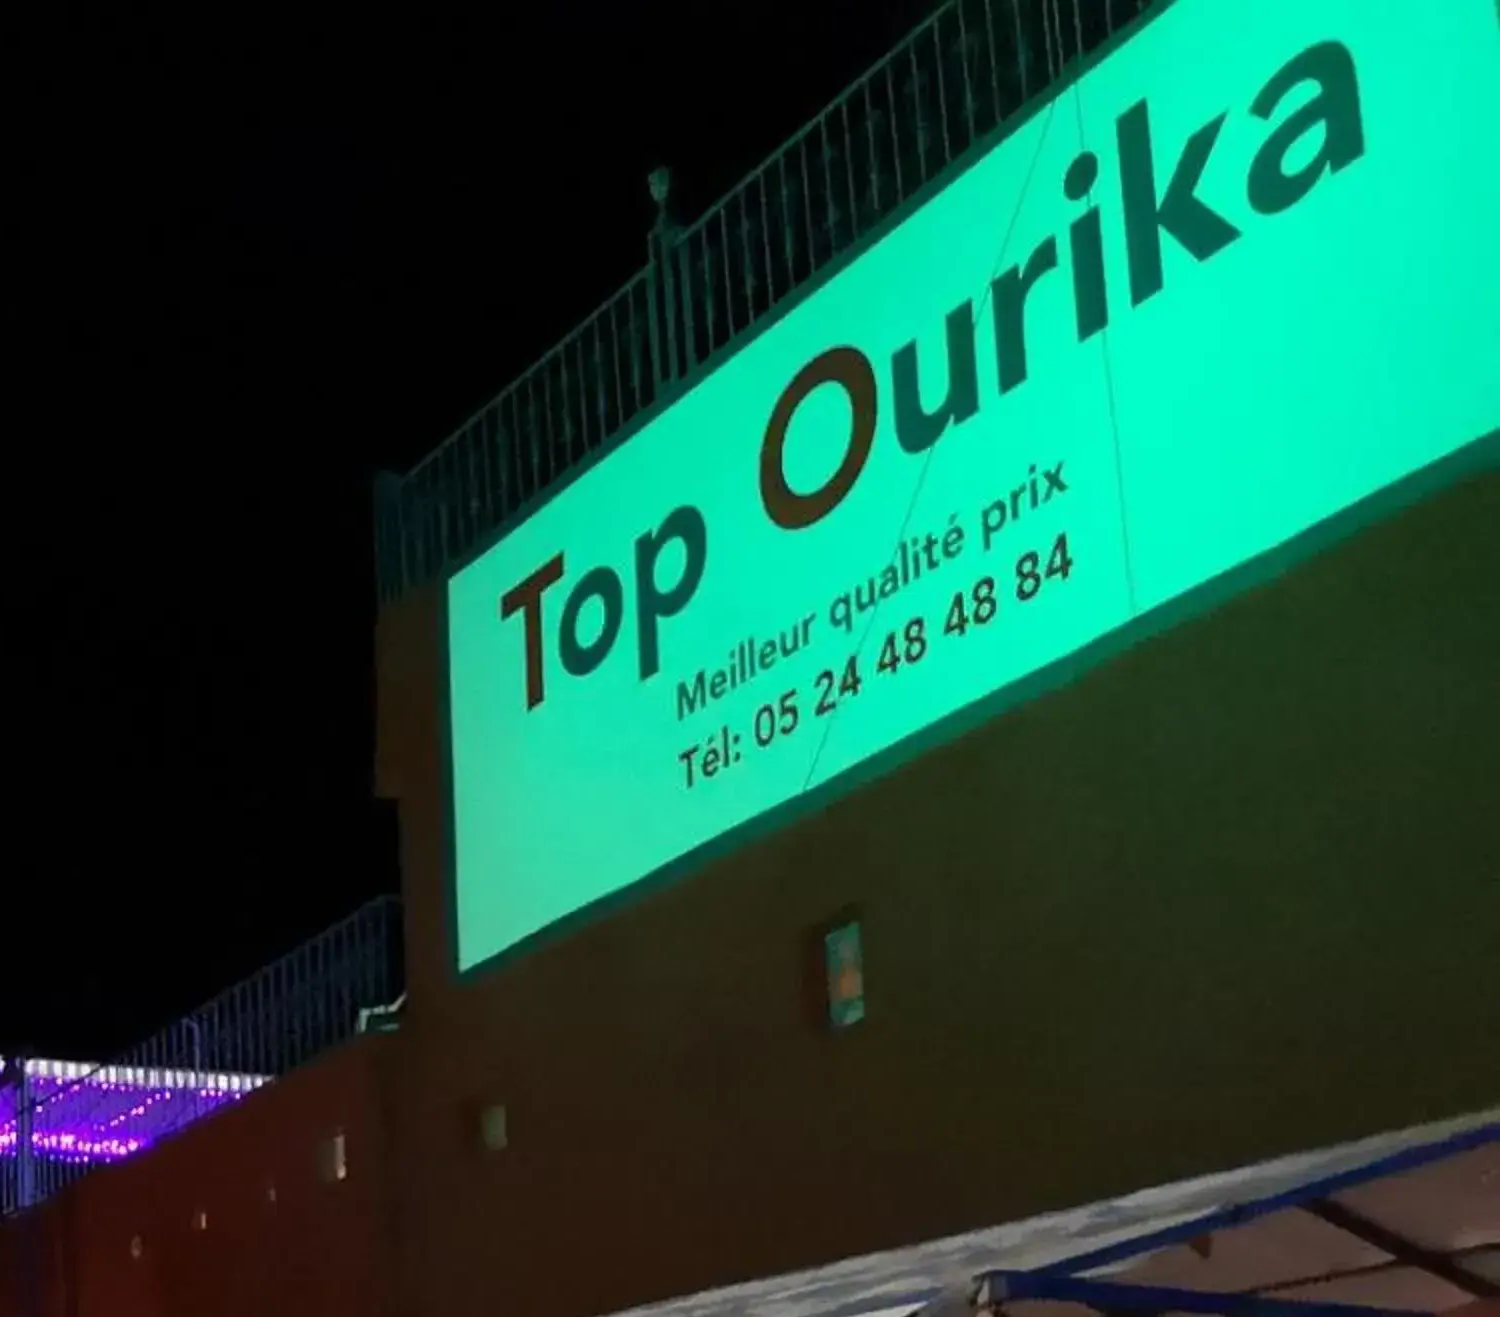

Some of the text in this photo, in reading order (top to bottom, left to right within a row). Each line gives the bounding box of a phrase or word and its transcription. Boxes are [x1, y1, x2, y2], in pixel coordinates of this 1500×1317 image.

[498, 38, 1366, 713] Top Ourika
[677, 461, 1069, 721] Meilleur qualité prix
[678, 532, 1073, 789] Tél: 05 24 48 48 84
